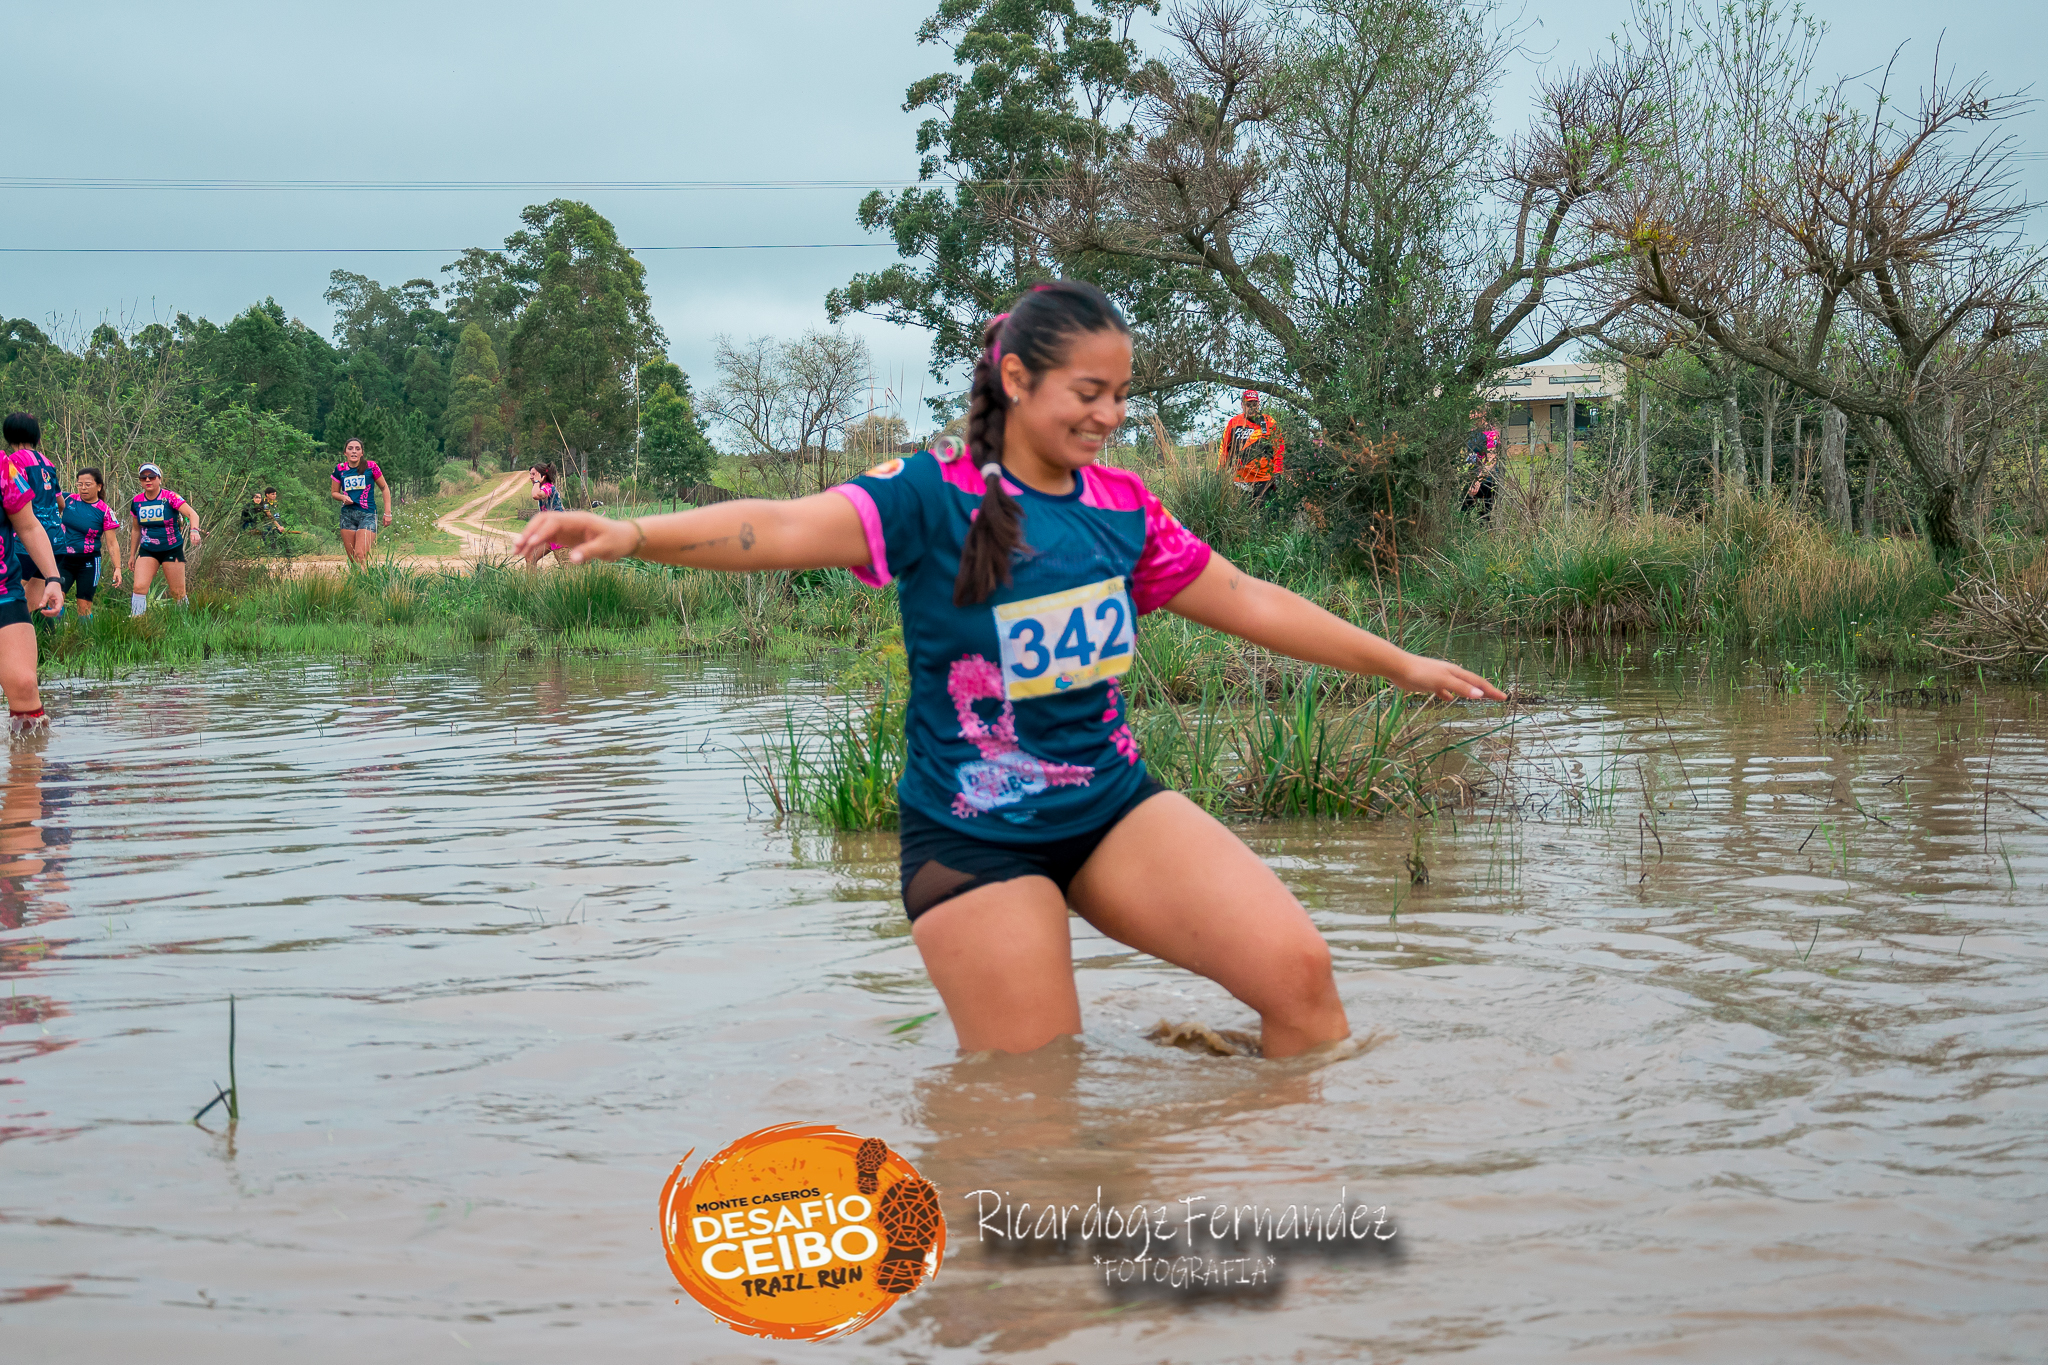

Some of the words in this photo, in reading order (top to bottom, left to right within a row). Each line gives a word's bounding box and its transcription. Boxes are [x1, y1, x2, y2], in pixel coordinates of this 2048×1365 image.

[345, 477, 365, 488] 337
[140, 508, 163, 519] 390
[1009, 598, 1129, 678] 342
